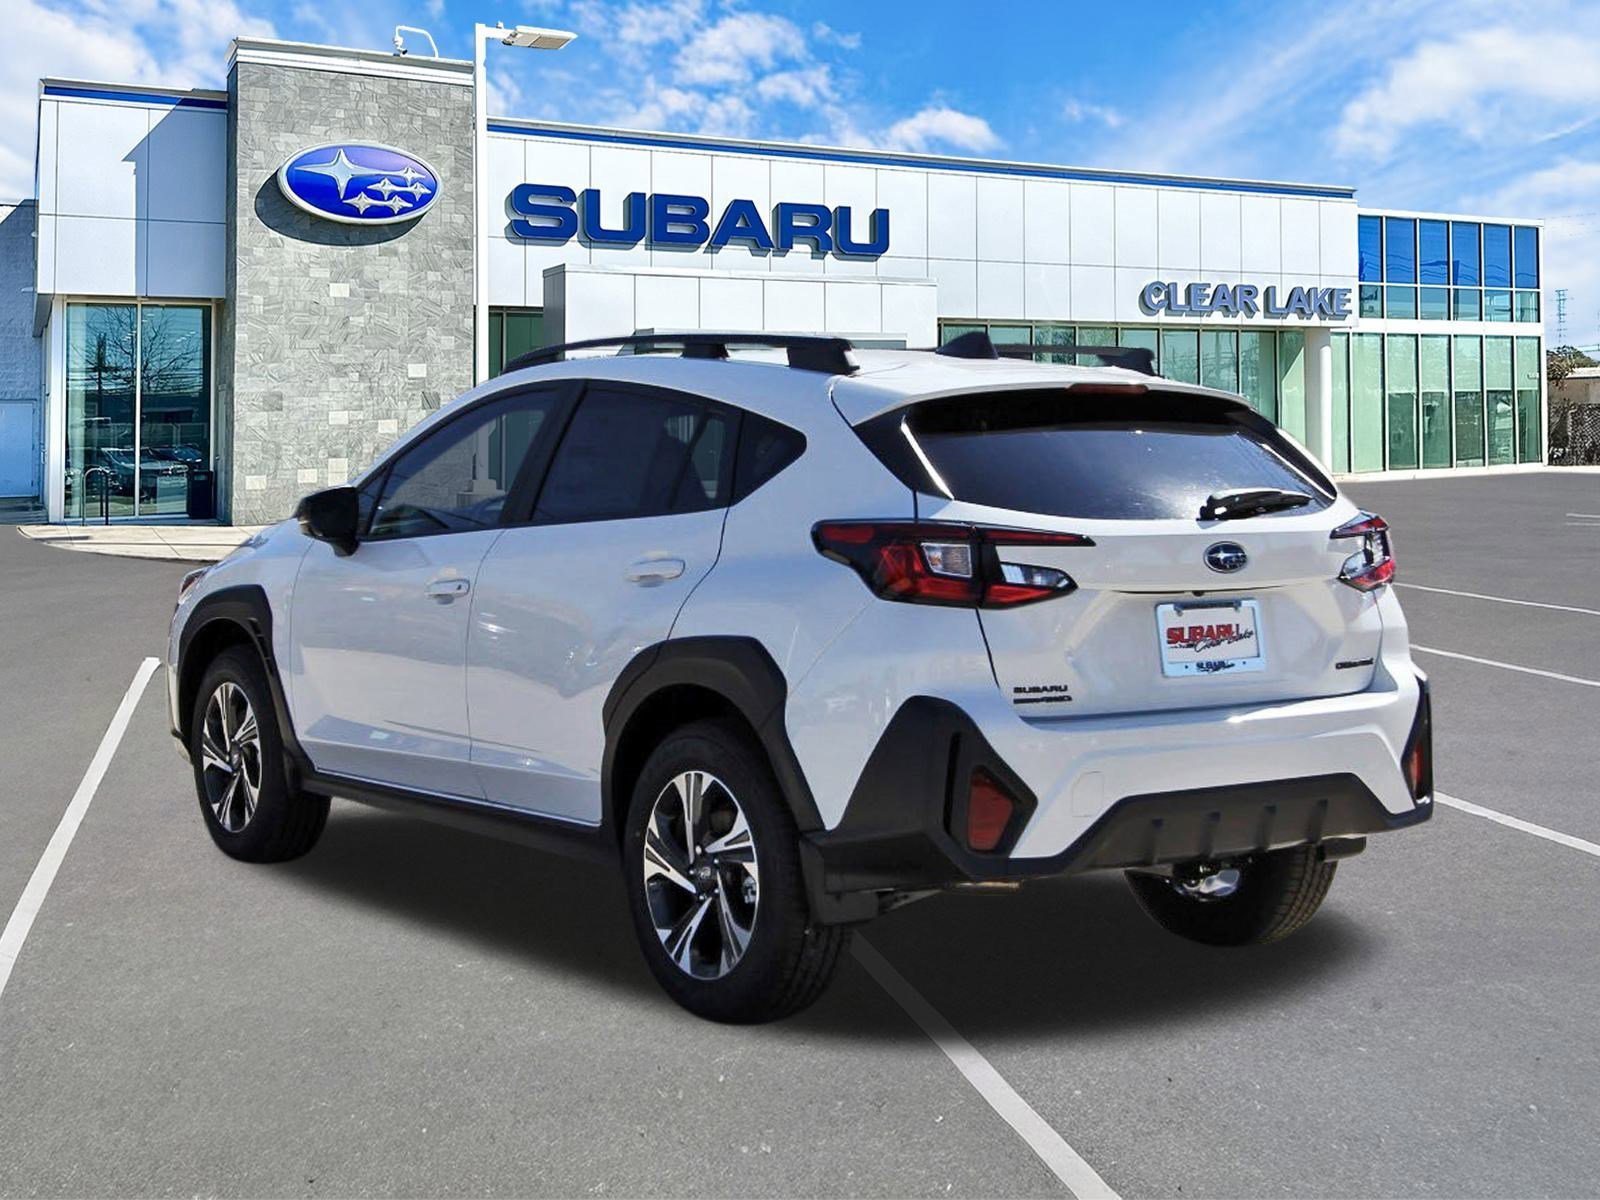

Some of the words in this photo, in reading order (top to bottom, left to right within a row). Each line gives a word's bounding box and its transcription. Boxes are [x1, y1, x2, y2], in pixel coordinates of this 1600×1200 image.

[506, 183, 890, 261] SUBARU
[1139, 281, 1260, 318] CLEAR
[1264, 286, 1353, 320] LAKE
[1166, 623, 1240, 645] SUBARU
[1013, 684, 1068, 693] SUBARU
